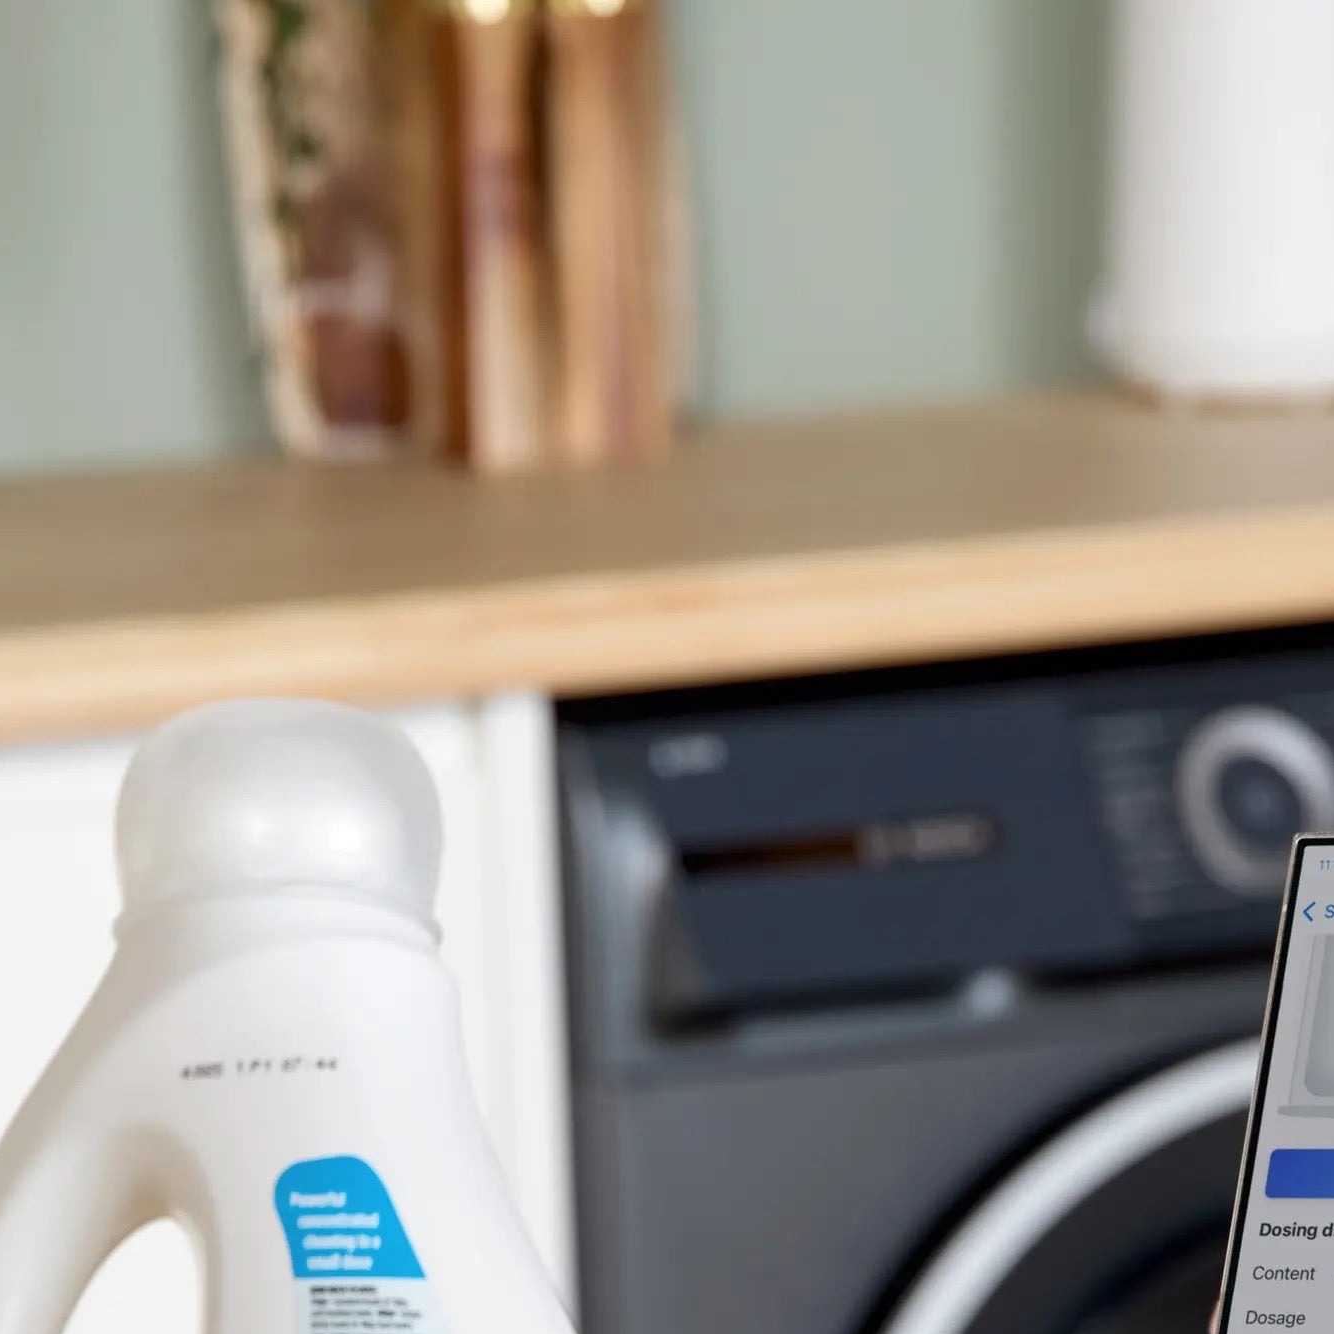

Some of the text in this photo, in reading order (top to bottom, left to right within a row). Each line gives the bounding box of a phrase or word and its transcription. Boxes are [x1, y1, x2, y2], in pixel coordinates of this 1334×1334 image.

[1259, 1222, 1318, 1240] Dosing
[1253, 1266, 1316, 1280] Content
[1246, 1310, 1305, 1328] Dosage
